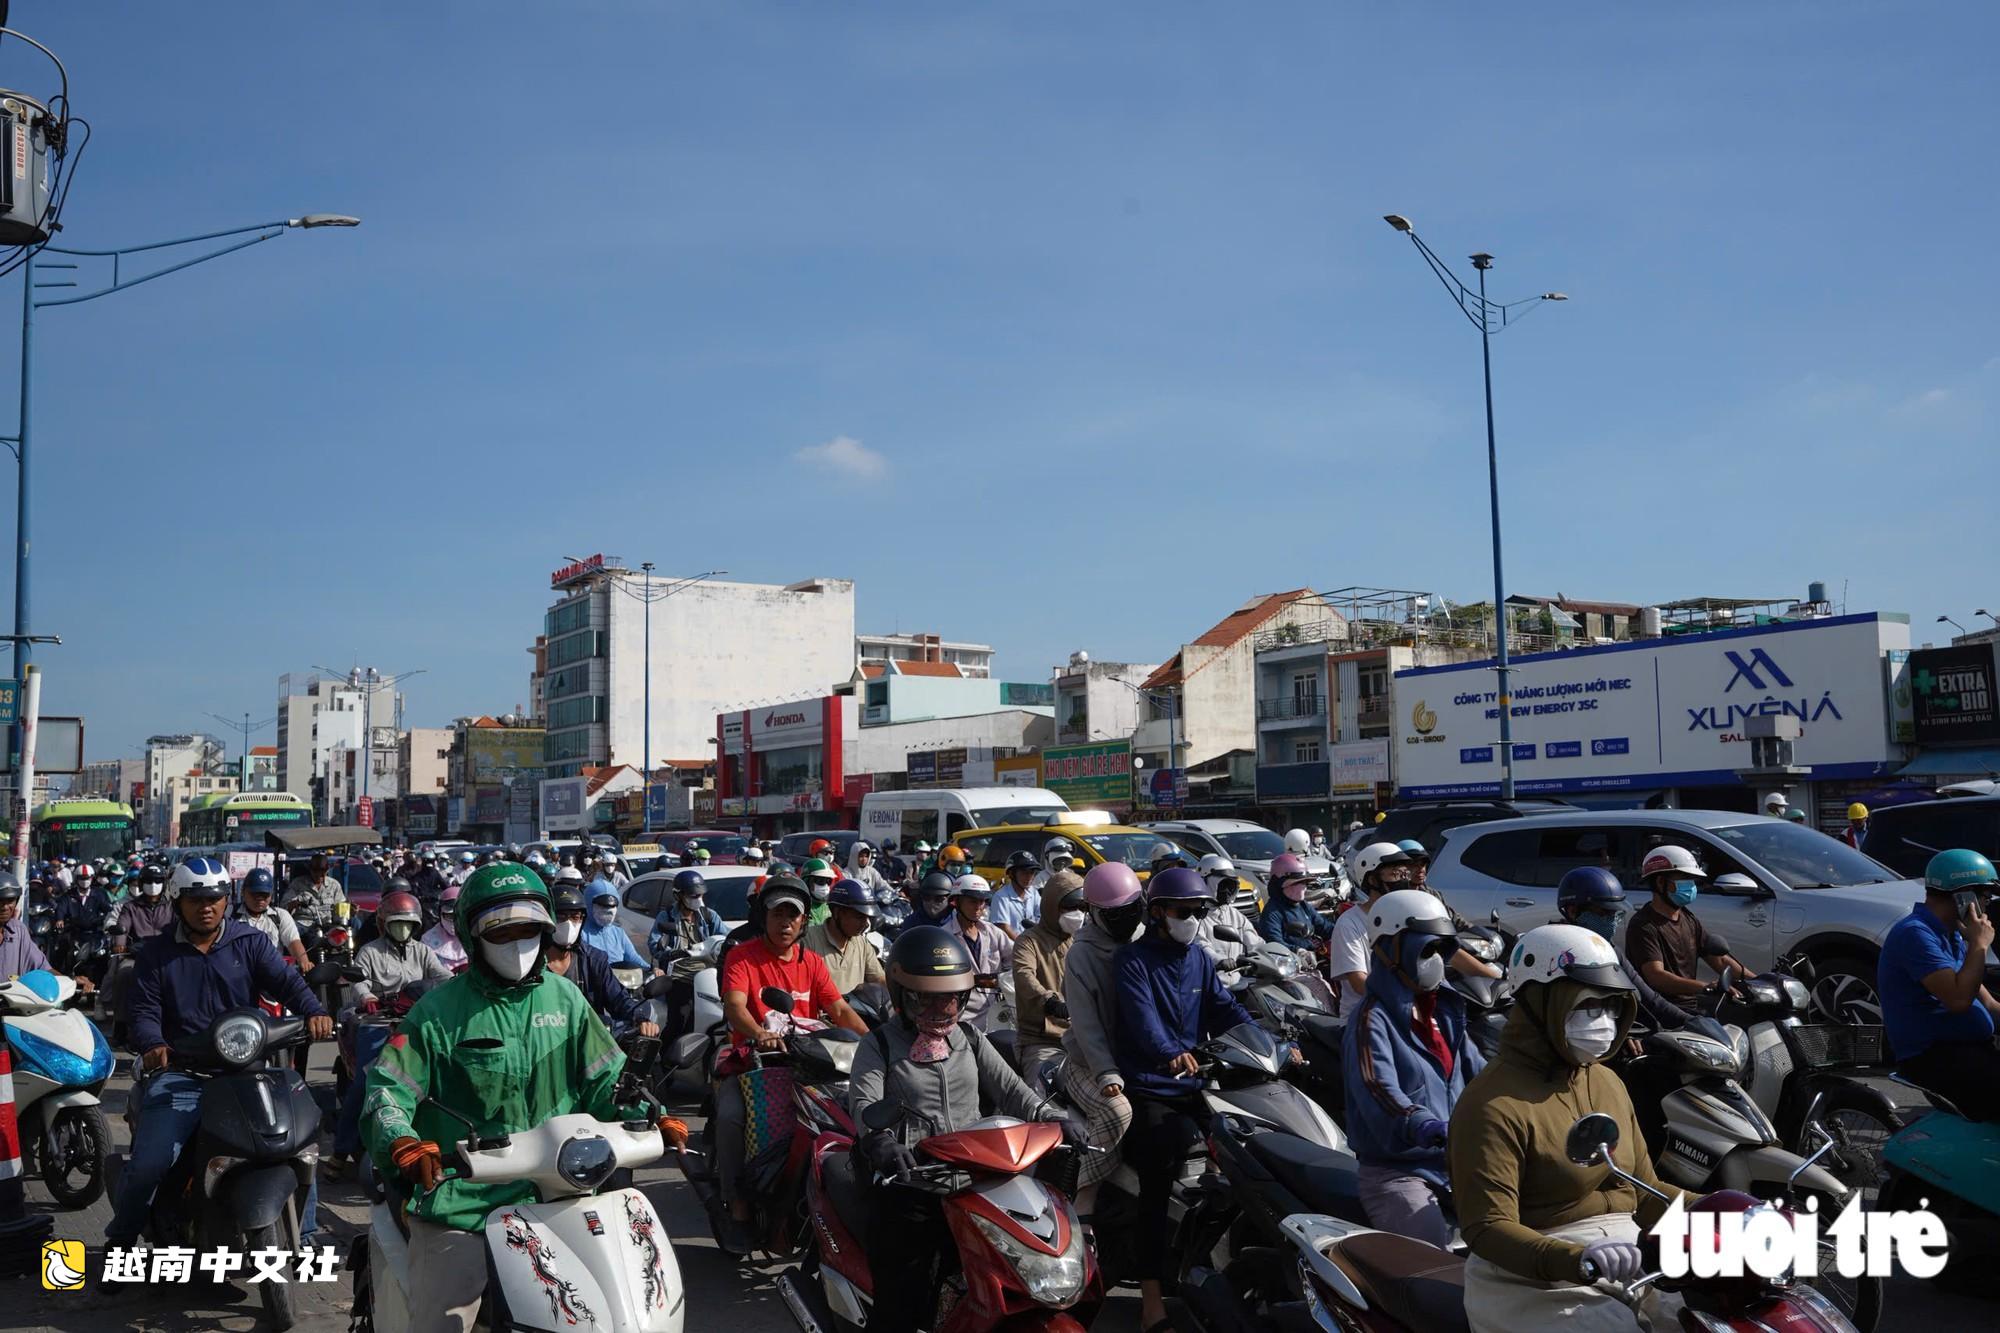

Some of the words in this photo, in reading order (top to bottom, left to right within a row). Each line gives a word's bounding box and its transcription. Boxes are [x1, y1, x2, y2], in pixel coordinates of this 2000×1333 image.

[1939, 671, 1987, 692] EXTRA
[1454, 692, 1482, 706] CÔNG
[1484, 692, 1497, 702] TY
[1533, 702, 1575, 715] ENERGY
[1578, 699, 1598, 711] JSC
[1961, 690, 1989, 711] BIO
[774, 712, 805, 726] HONDA
[1045, 759, 1060, 780] KHO
[491, 873, 526, 888] Grab
[531, 1010, 567, 1028] Grab
[1675, 1139, 1709, 1165] YAMAHA
